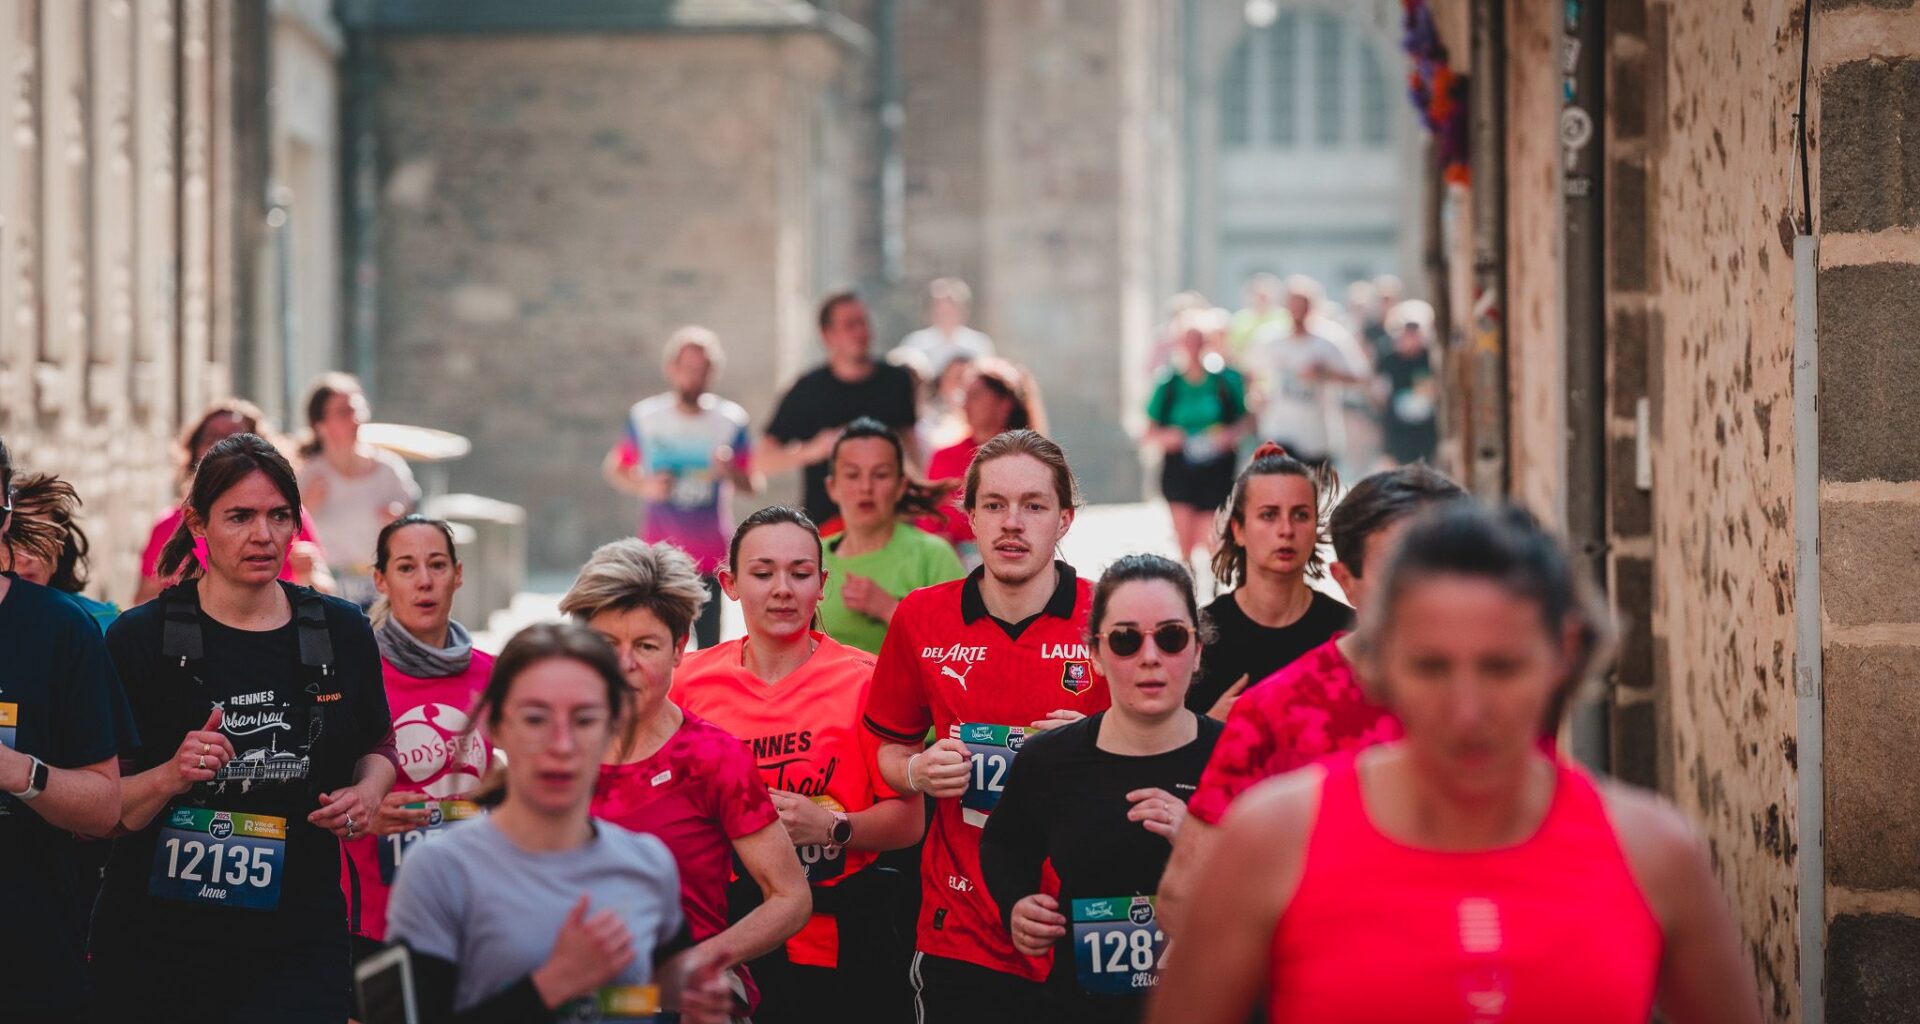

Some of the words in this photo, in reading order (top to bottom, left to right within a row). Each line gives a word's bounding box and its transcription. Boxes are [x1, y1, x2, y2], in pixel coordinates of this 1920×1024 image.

[922, 647, 944, 658] DEL
[934, 643, 988, 664] ARTE
[231, 690, 274, 705] RENNES
[212, 822, 231, 835] 7KM
[166, 838, 275, 888] 12135
[198, 884, 227, 900] Anne
[1131, 971, 1160, 988] Elise
